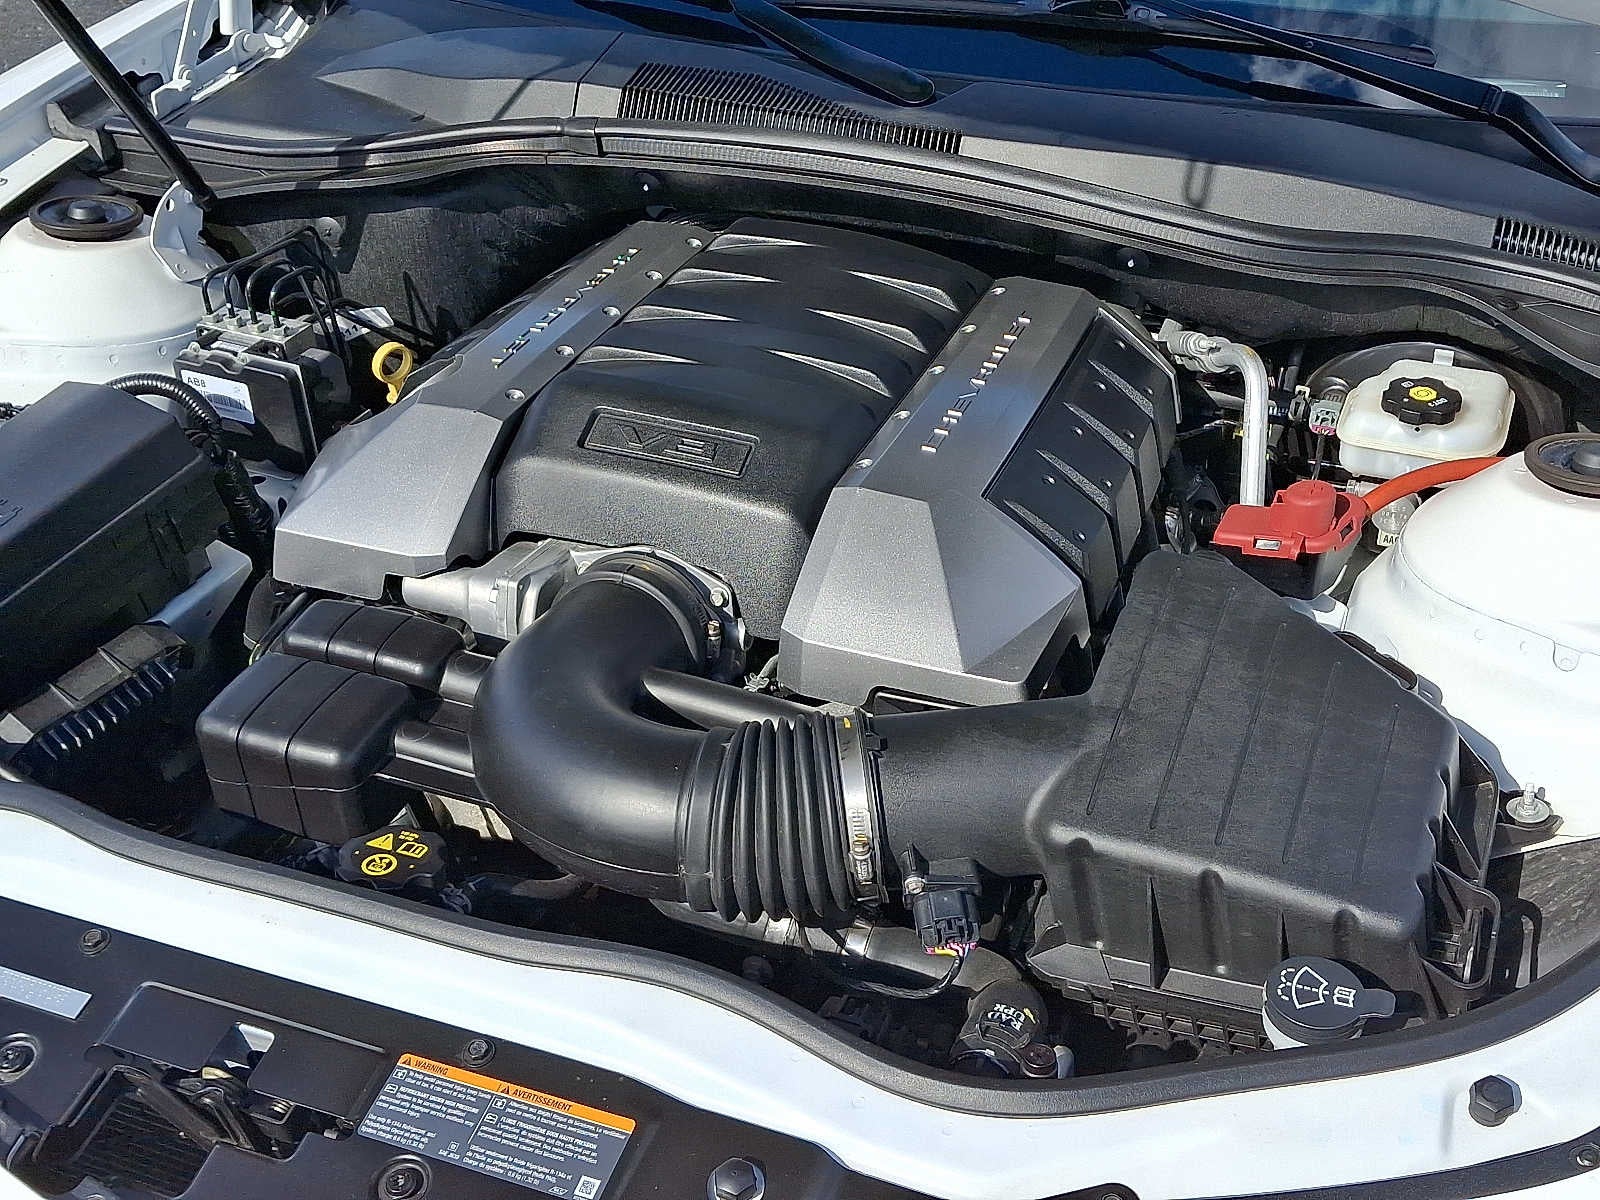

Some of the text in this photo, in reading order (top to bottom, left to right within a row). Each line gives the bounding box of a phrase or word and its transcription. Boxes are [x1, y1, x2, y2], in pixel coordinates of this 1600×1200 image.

[920, 310, 1032, 453] CHEVROLET
[414, 1059, 449, 1076] WARNING
[512, 1088, 573, 1111] AVERTISSEMENT
